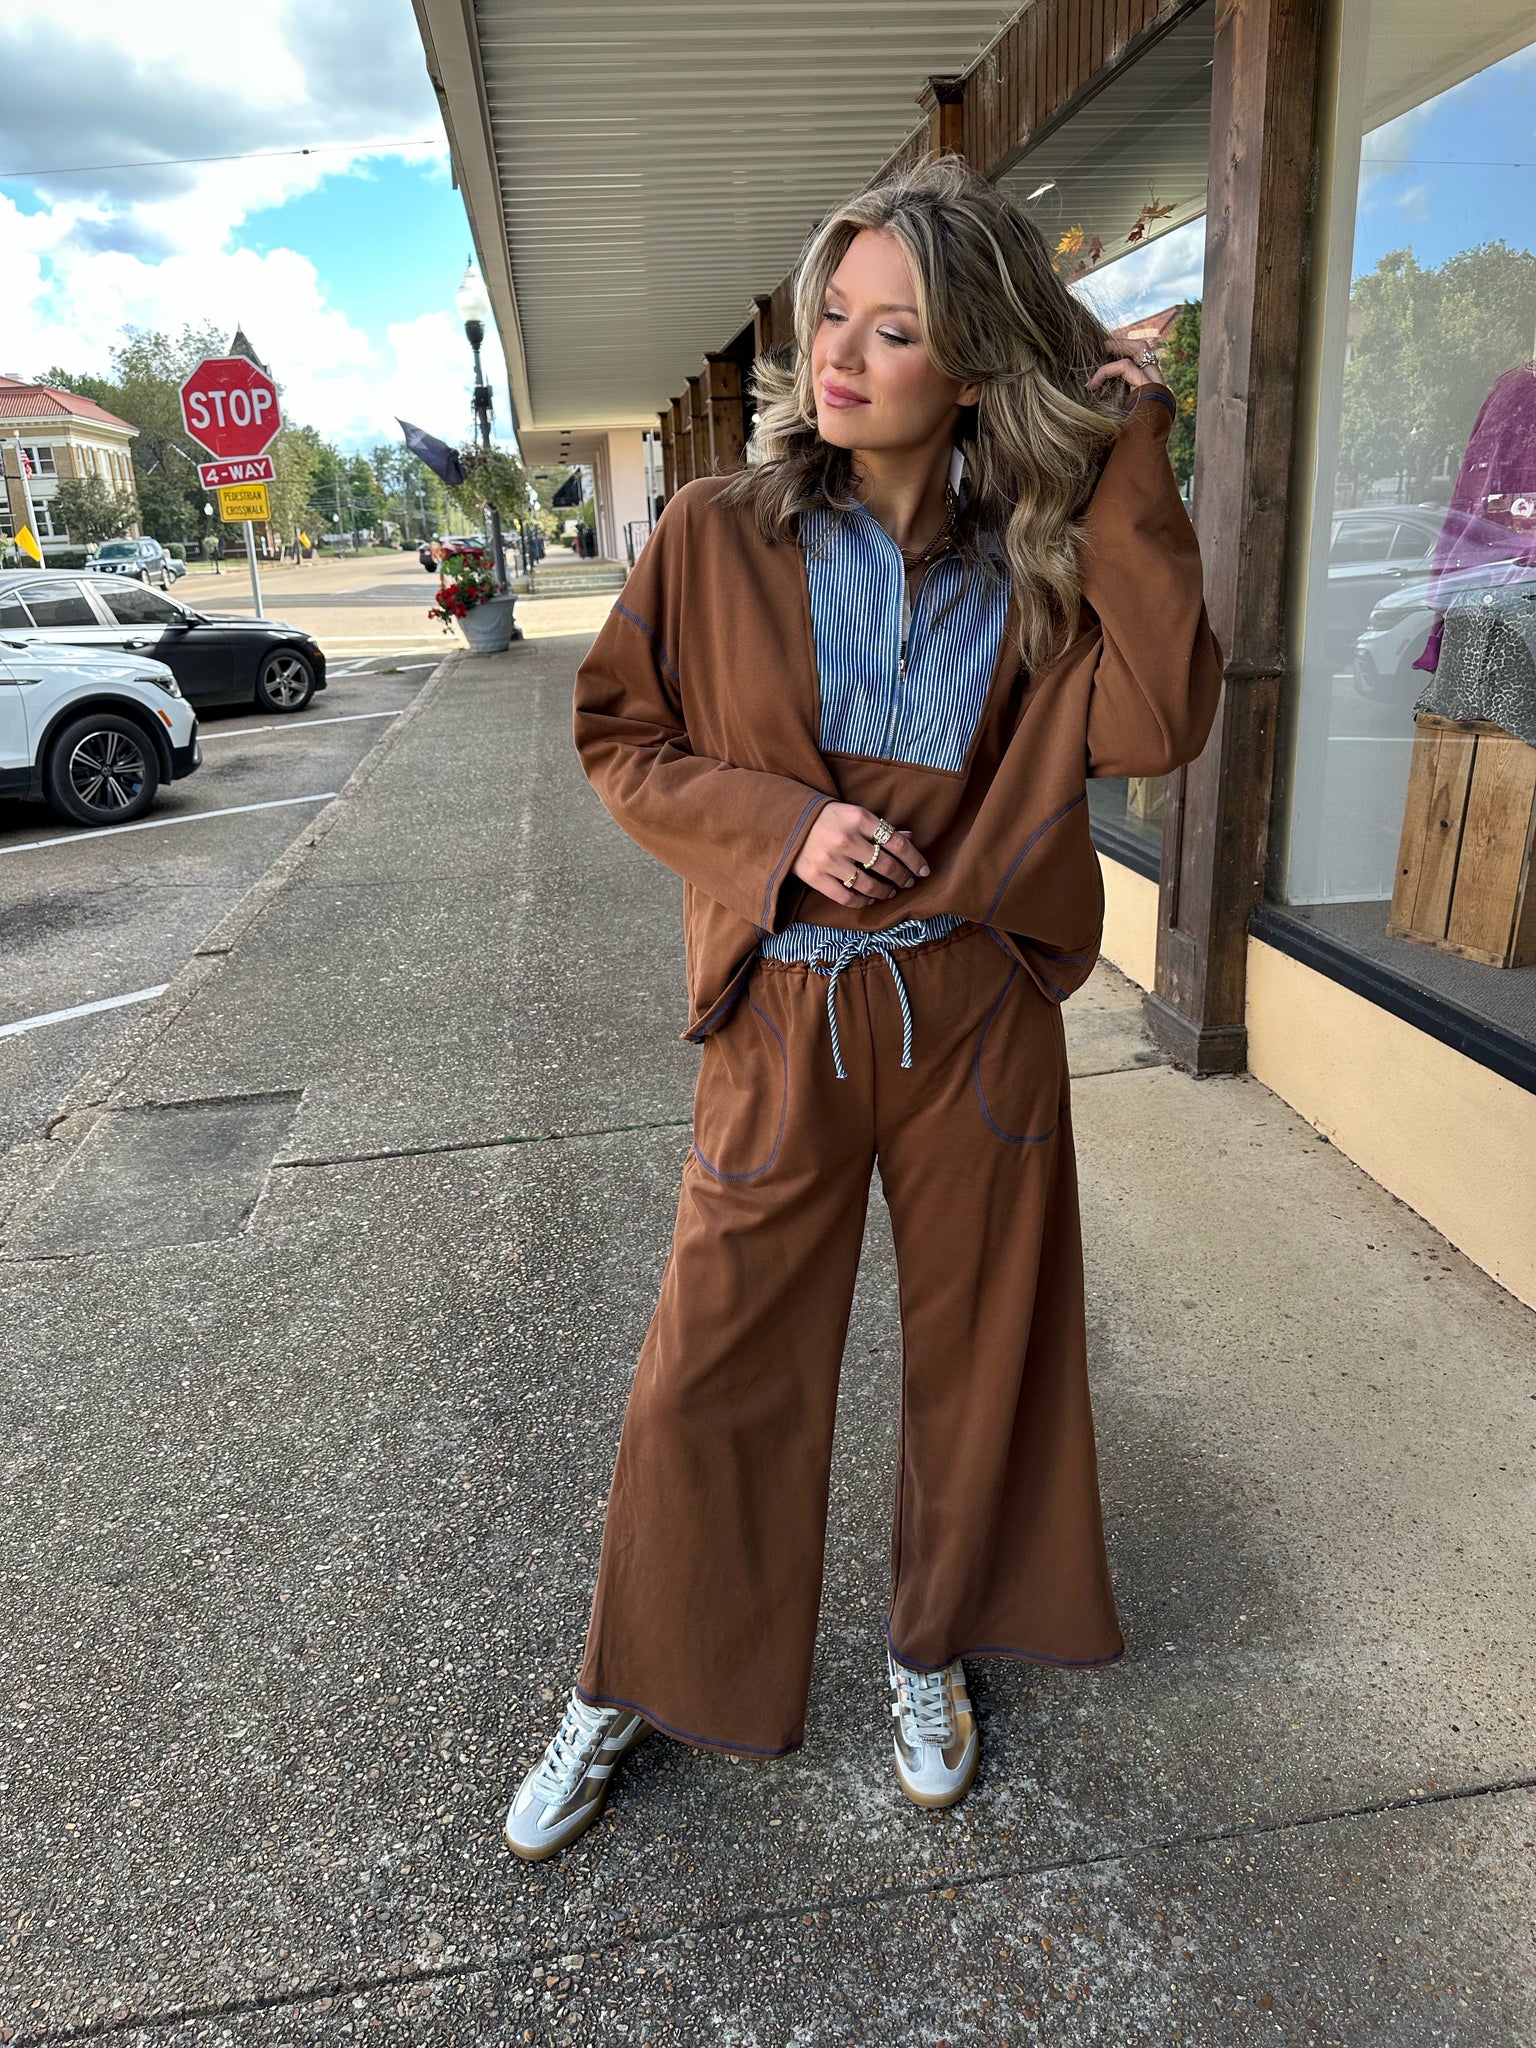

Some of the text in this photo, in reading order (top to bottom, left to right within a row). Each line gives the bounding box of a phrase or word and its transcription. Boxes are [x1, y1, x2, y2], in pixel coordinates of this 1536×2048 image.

[189, 388, 272, 429] STOP
[206, 461, 266, 483] 4-WAY
[223, 490, 262, 501] PEDESTRIAN
[225, 505, 265, 516] CROSSWALK
